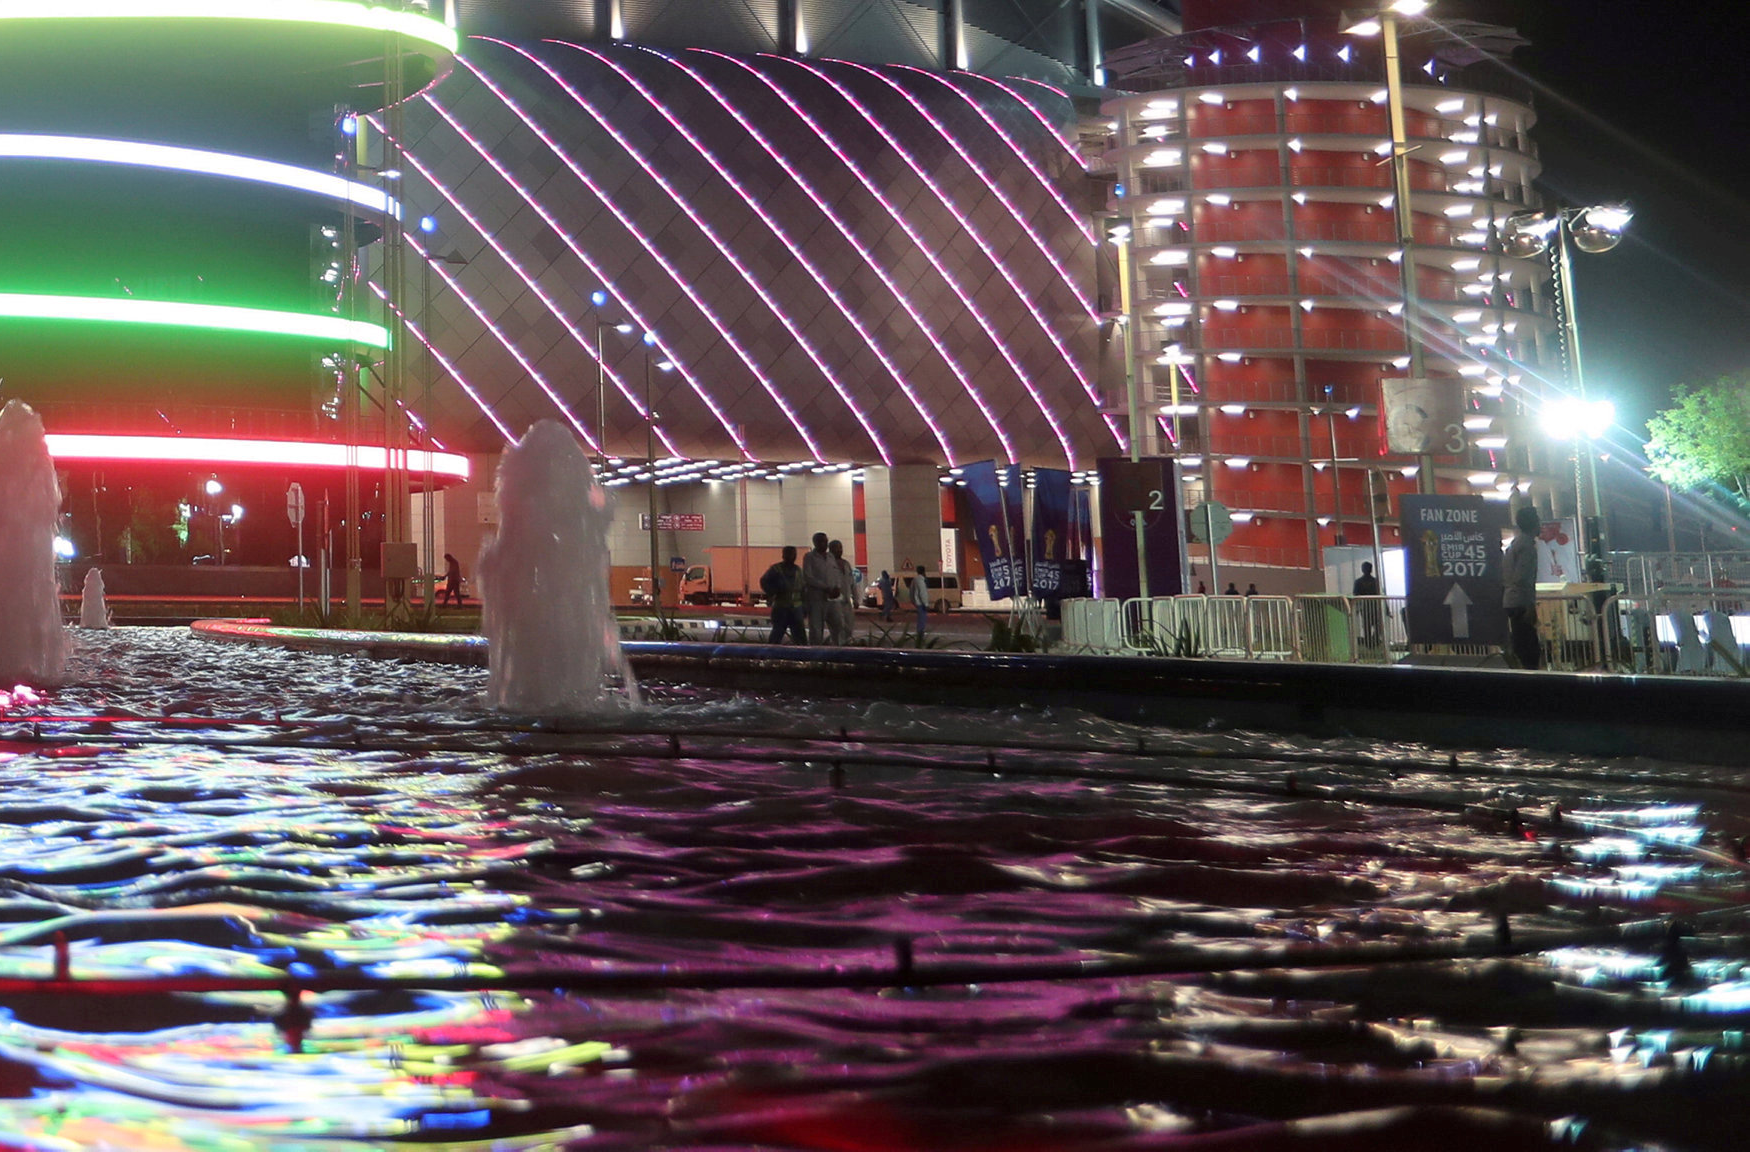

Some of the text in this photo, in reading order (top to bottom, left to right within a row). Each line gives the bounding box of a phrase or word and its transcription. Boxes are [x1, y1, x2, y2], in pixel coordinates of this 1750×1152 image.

[1444, 423, 1465, 453] 3
[1149, 490, 1164, 510] 2
[1420, 508, 1479, 523] FAN ZONE
[1441, 543, 1465, 551] EMIR
[1464, 545, 1486, 559] 45
[1441, 551, 1462, 559] CUP
[1442, 561, 1487, 576] 2017
